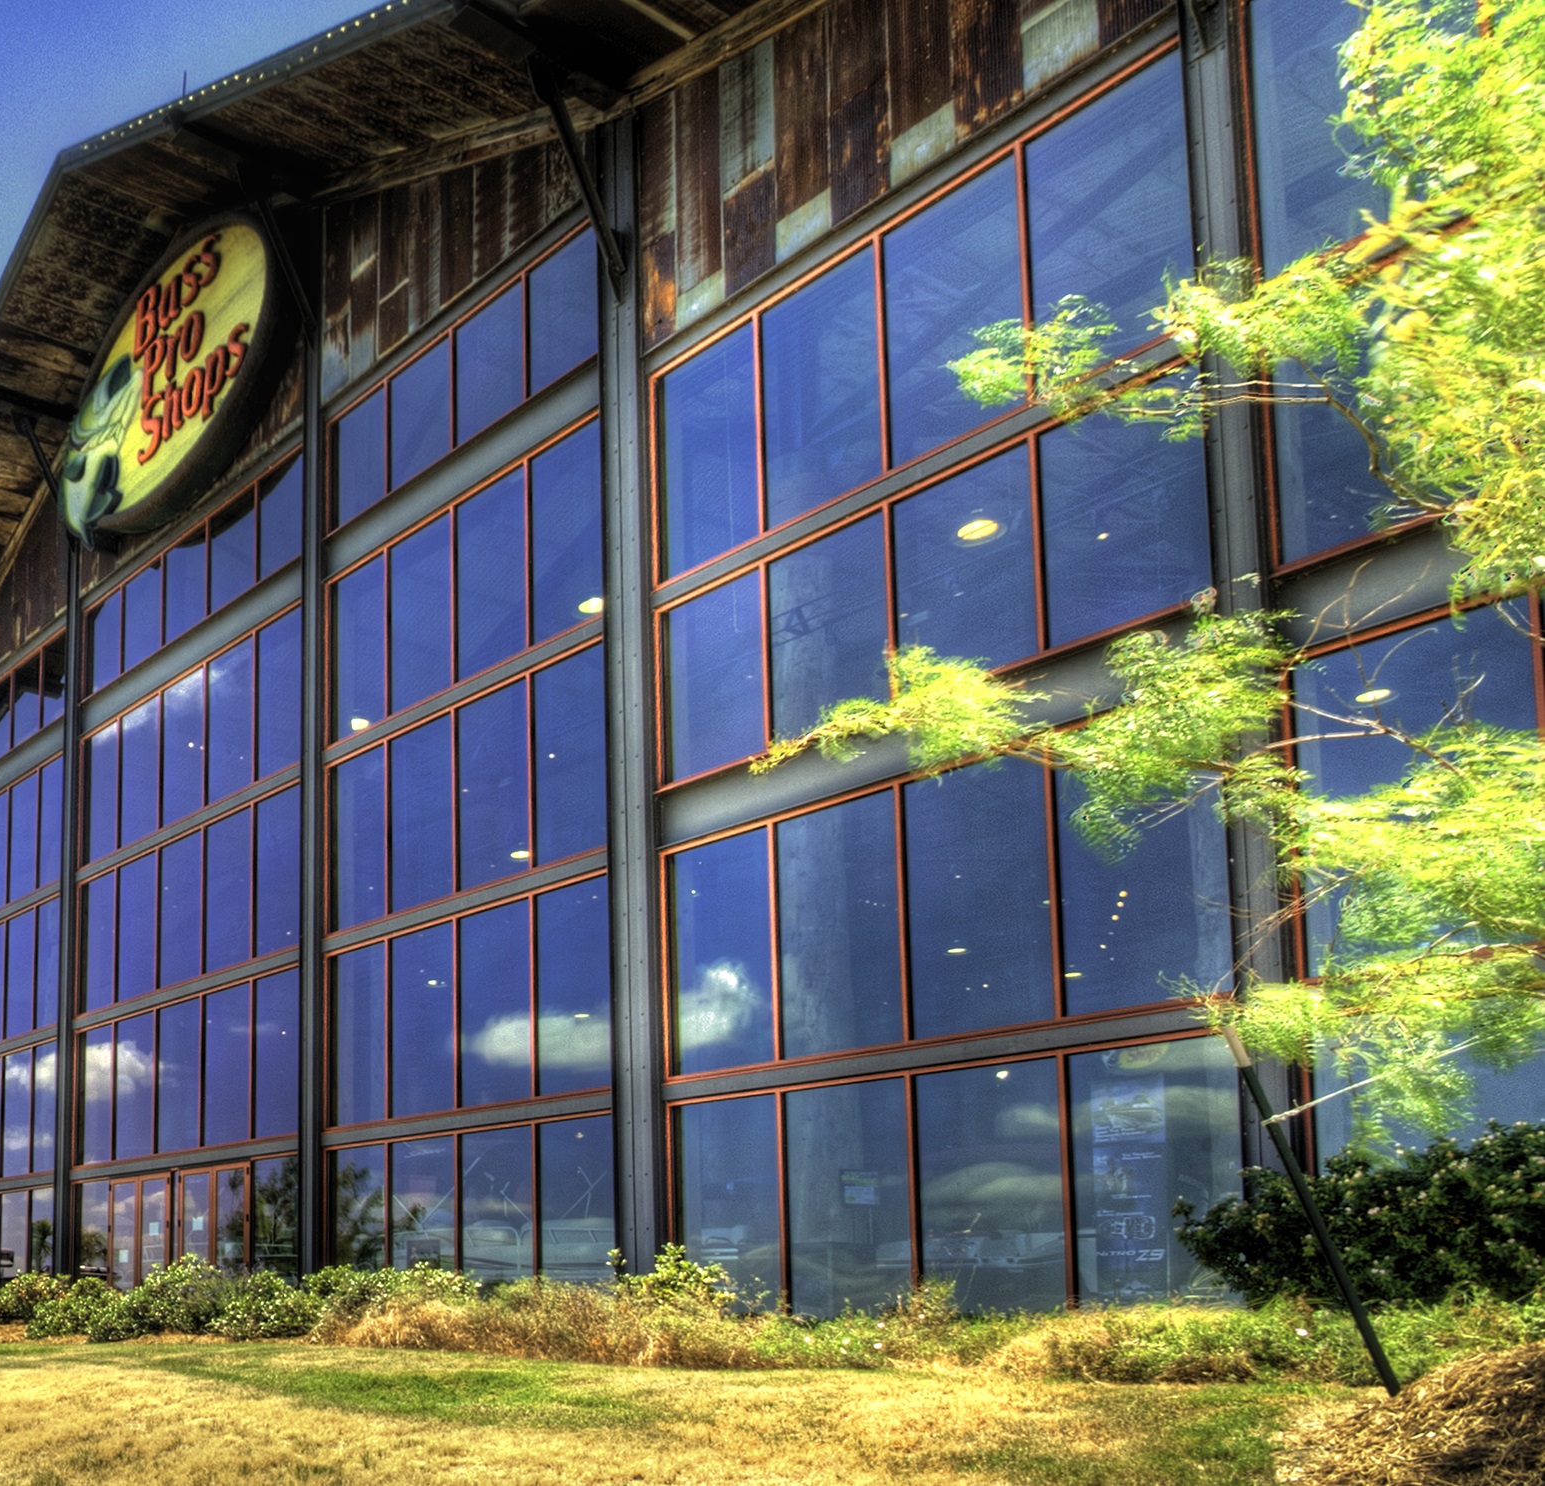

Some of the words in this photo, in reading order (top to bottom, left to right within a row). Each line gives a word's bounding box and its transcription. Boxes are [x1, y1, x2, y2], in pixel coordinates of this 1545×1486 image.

[134, 234, 220, 362] Bass
[142, 311, 205, 407] Pro
[137, 323, 250, 464] Shops
